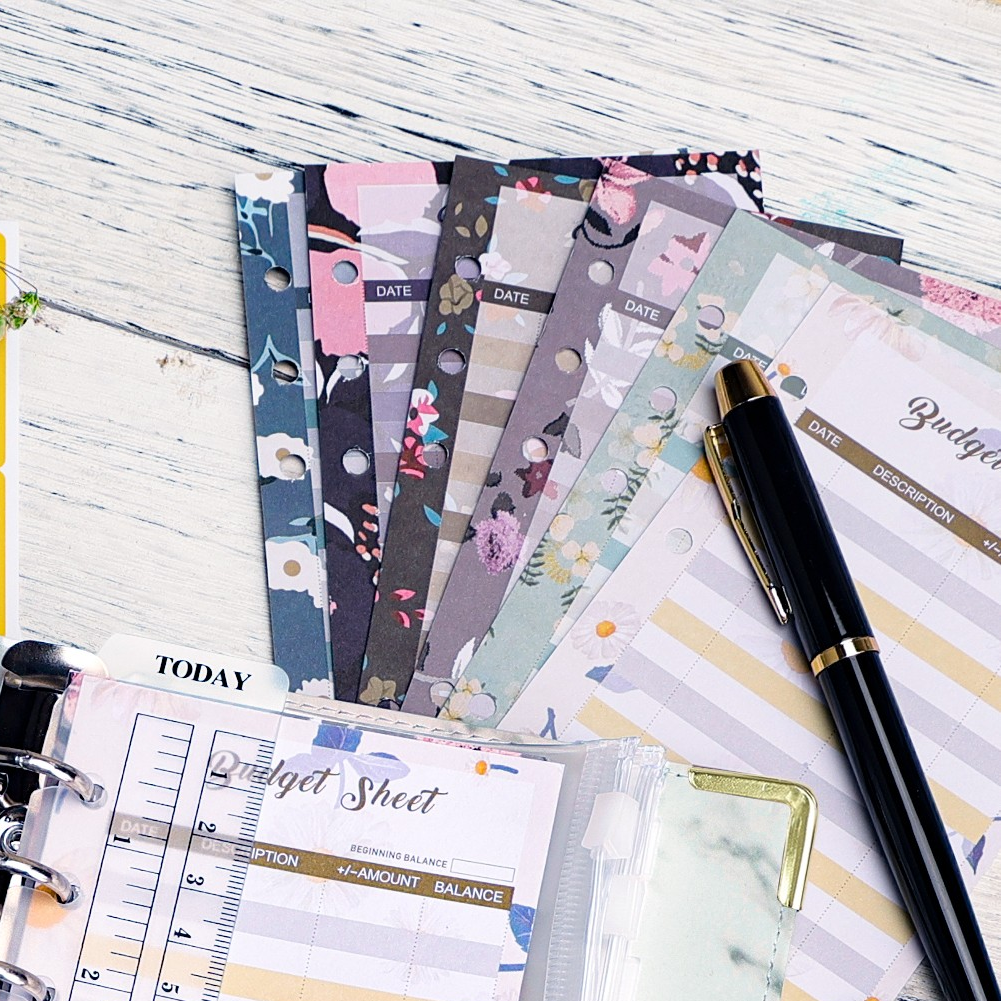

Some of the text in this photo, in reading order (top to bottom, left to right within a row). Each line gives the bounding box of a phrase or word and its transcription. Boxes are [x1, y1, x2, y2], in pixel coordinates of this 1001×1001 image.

[376, 285, 413, 297] DATE
[493, 288, 530, 305] DATE
[624, 300, 660, 321] DATE
[808, 420, 955, 523] DATE DESCRIPTION
[156, 655, 252, 691] TODAY
[210, 770, 228, 779] 1
[205, 750, 448, 814] Budget Sheet
[199, 820, 217, 833] 2
[113, 833, 131, 844] 1
[120, 819, 160, 836] DATE
[434, 880, 504, 904] BALANCE
[350, 844, 448, 869] BEGINNING BALANCE
[186, 873, 205, 886] 3
[173, 927, 192, 939] 4
[81, 968, 100, 982] 2
[160, 981, 180, 995] 5
